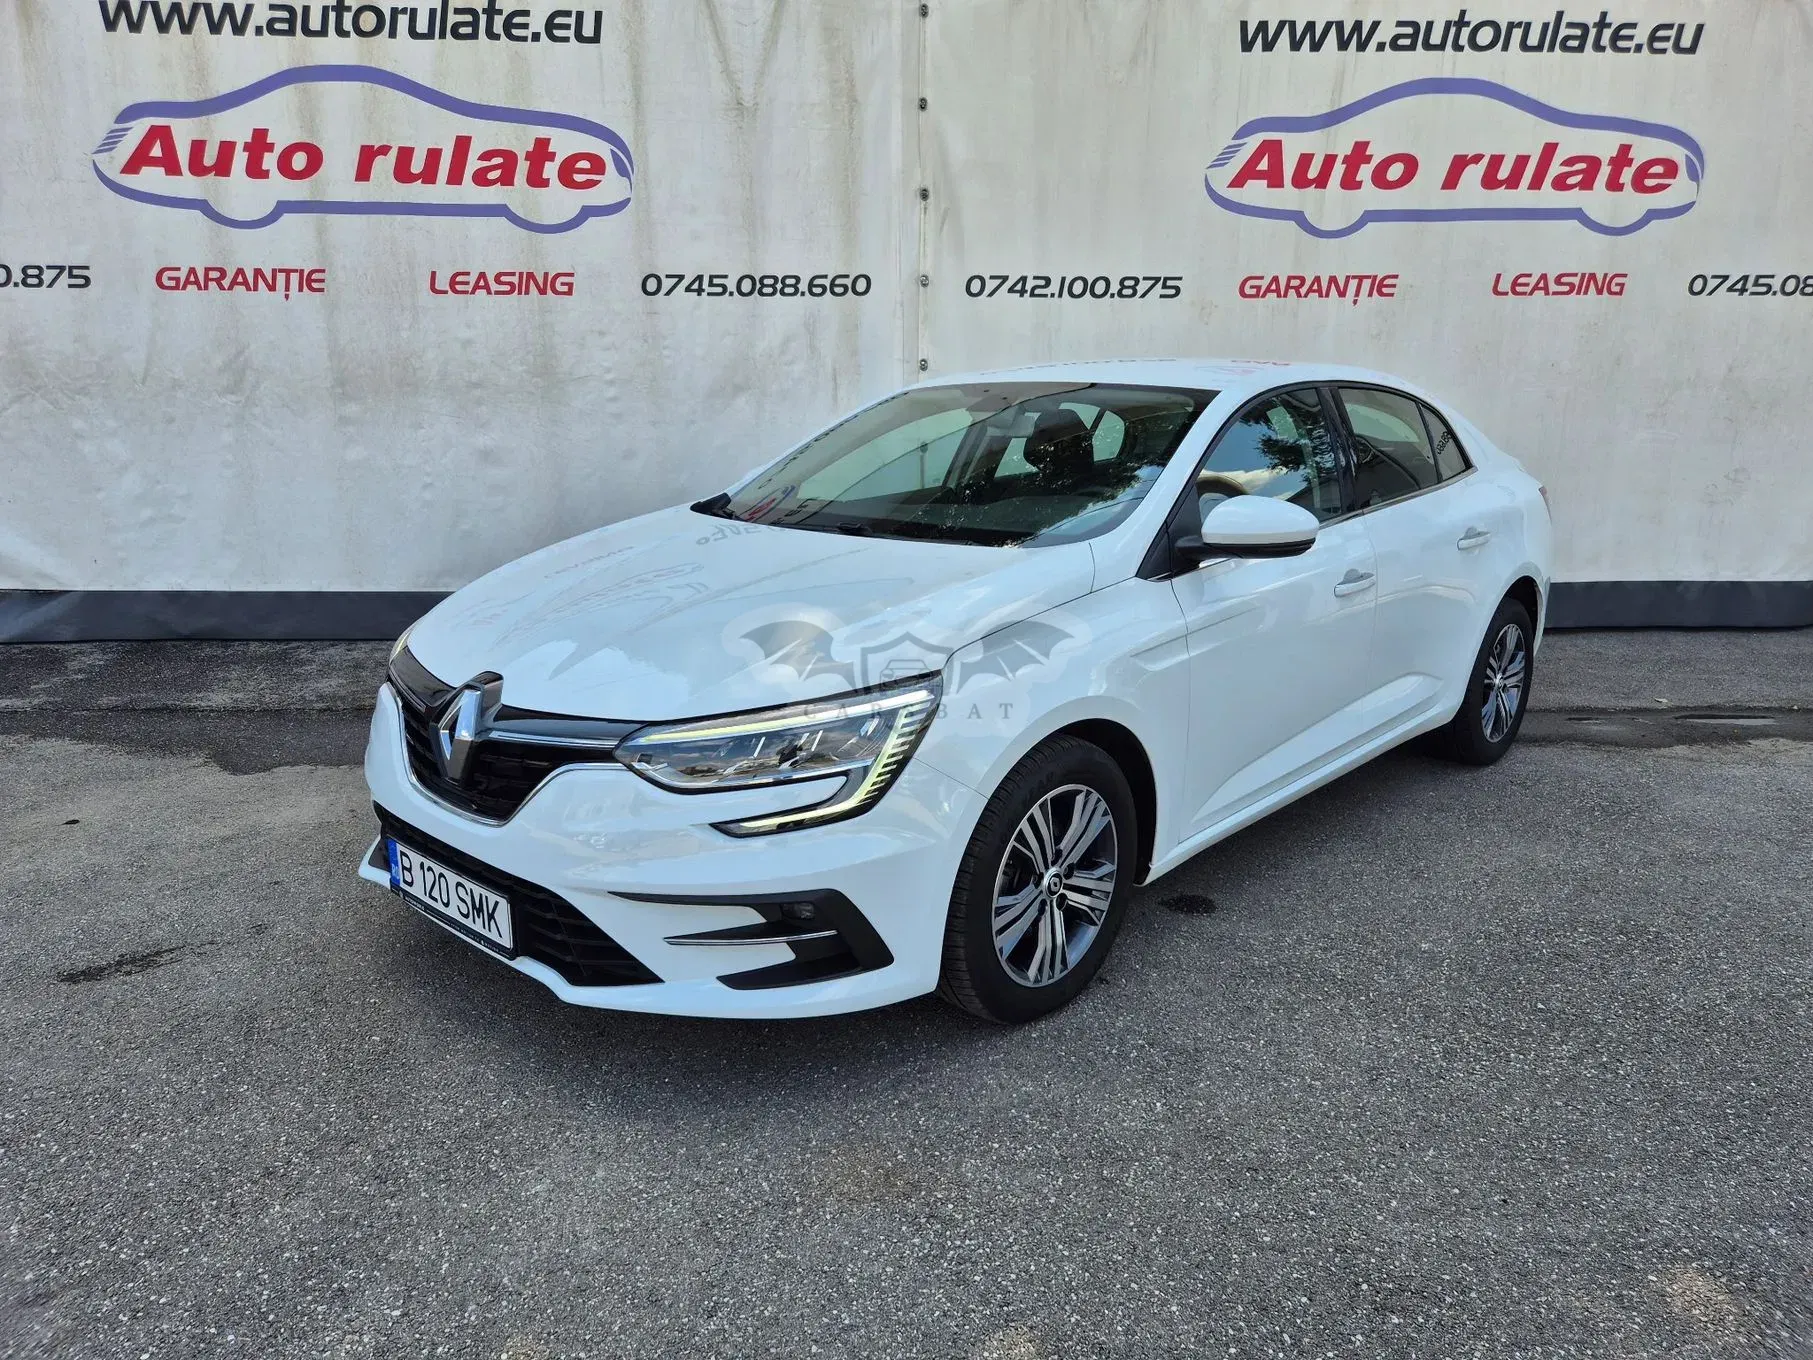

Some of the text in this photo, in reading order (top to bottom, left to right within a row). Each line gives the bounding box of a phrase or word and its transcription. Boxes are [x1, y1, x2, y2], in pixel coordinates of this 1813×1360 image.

[98, 0, 604, 44] www.autorulate.eu
[1239, 9, 1705, 55] www.autorulate.eu
[120, 124, 607, 190] Auto rulate
[1227, 139, 1679, 195] Auto rulate
[155, 266, 325, 301] GARANȚIE
[430, 270, 575, 296] LEASING
[641, 273, 872, 298] 0745.088.660
[965, 274, 1182, 299] 0742.100.875
[1239, 274, 1399, 307] GARANȚIE
[1492, 273, 1628, 297] LEASING
[400, 850, 414, 888] B
[420, 861, 451, 908] 120
[455, 881, 503, 938] SMK
